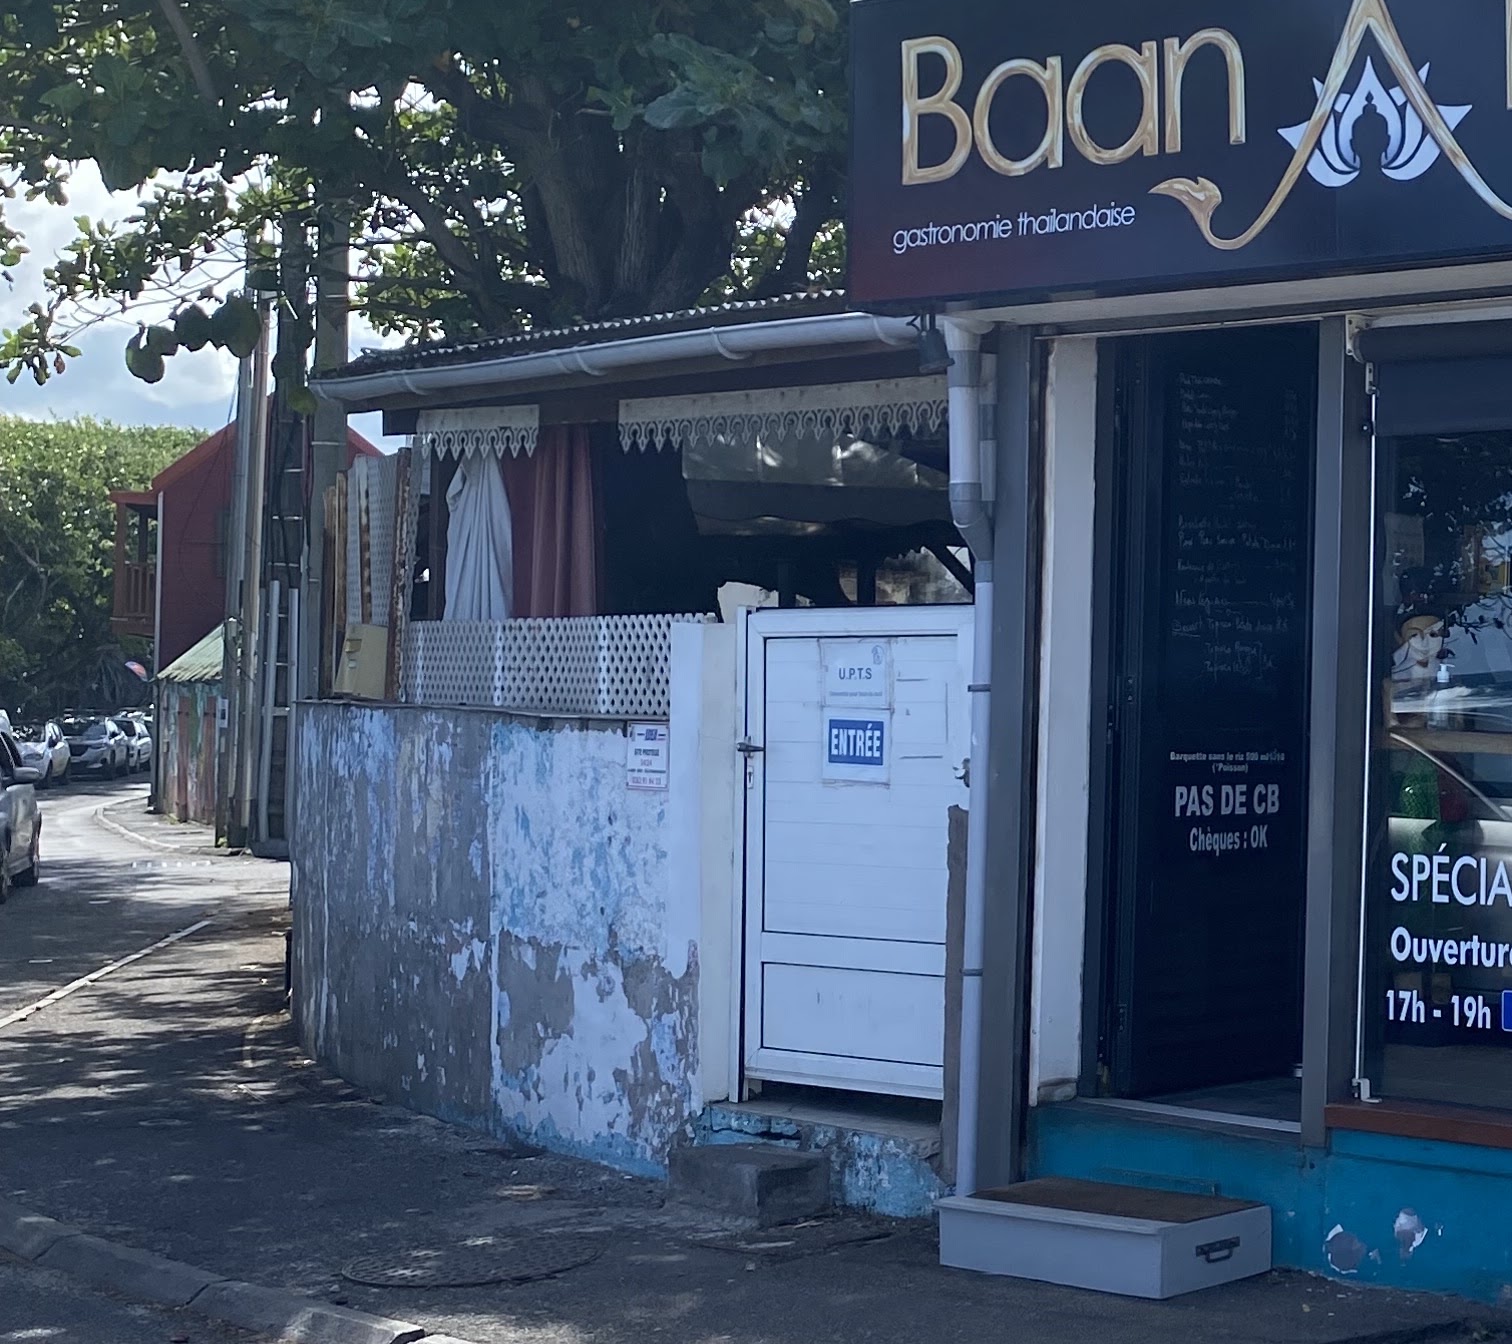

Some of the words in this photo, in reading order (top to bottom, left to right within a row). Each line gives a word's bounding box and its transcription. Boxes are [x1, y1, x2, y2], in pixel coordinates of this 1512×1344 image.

[902, 27, 1246, 186] Baan
[893, 214, 1012, 254] gastronomie
[830, 723, 881, 758] ENTRÉE
[1175, 785, 1214, 817] PAS
[1221, 784, 1247, 815] DE
[1253, 784, 1280, 814] CB
[1190, 826, 1240, 857] Chèques
[1250, 824, 1268, 848] OK
[1385, 989, 1426, 1023] 17h
[1451, 994, 1492, 1030] 19h
